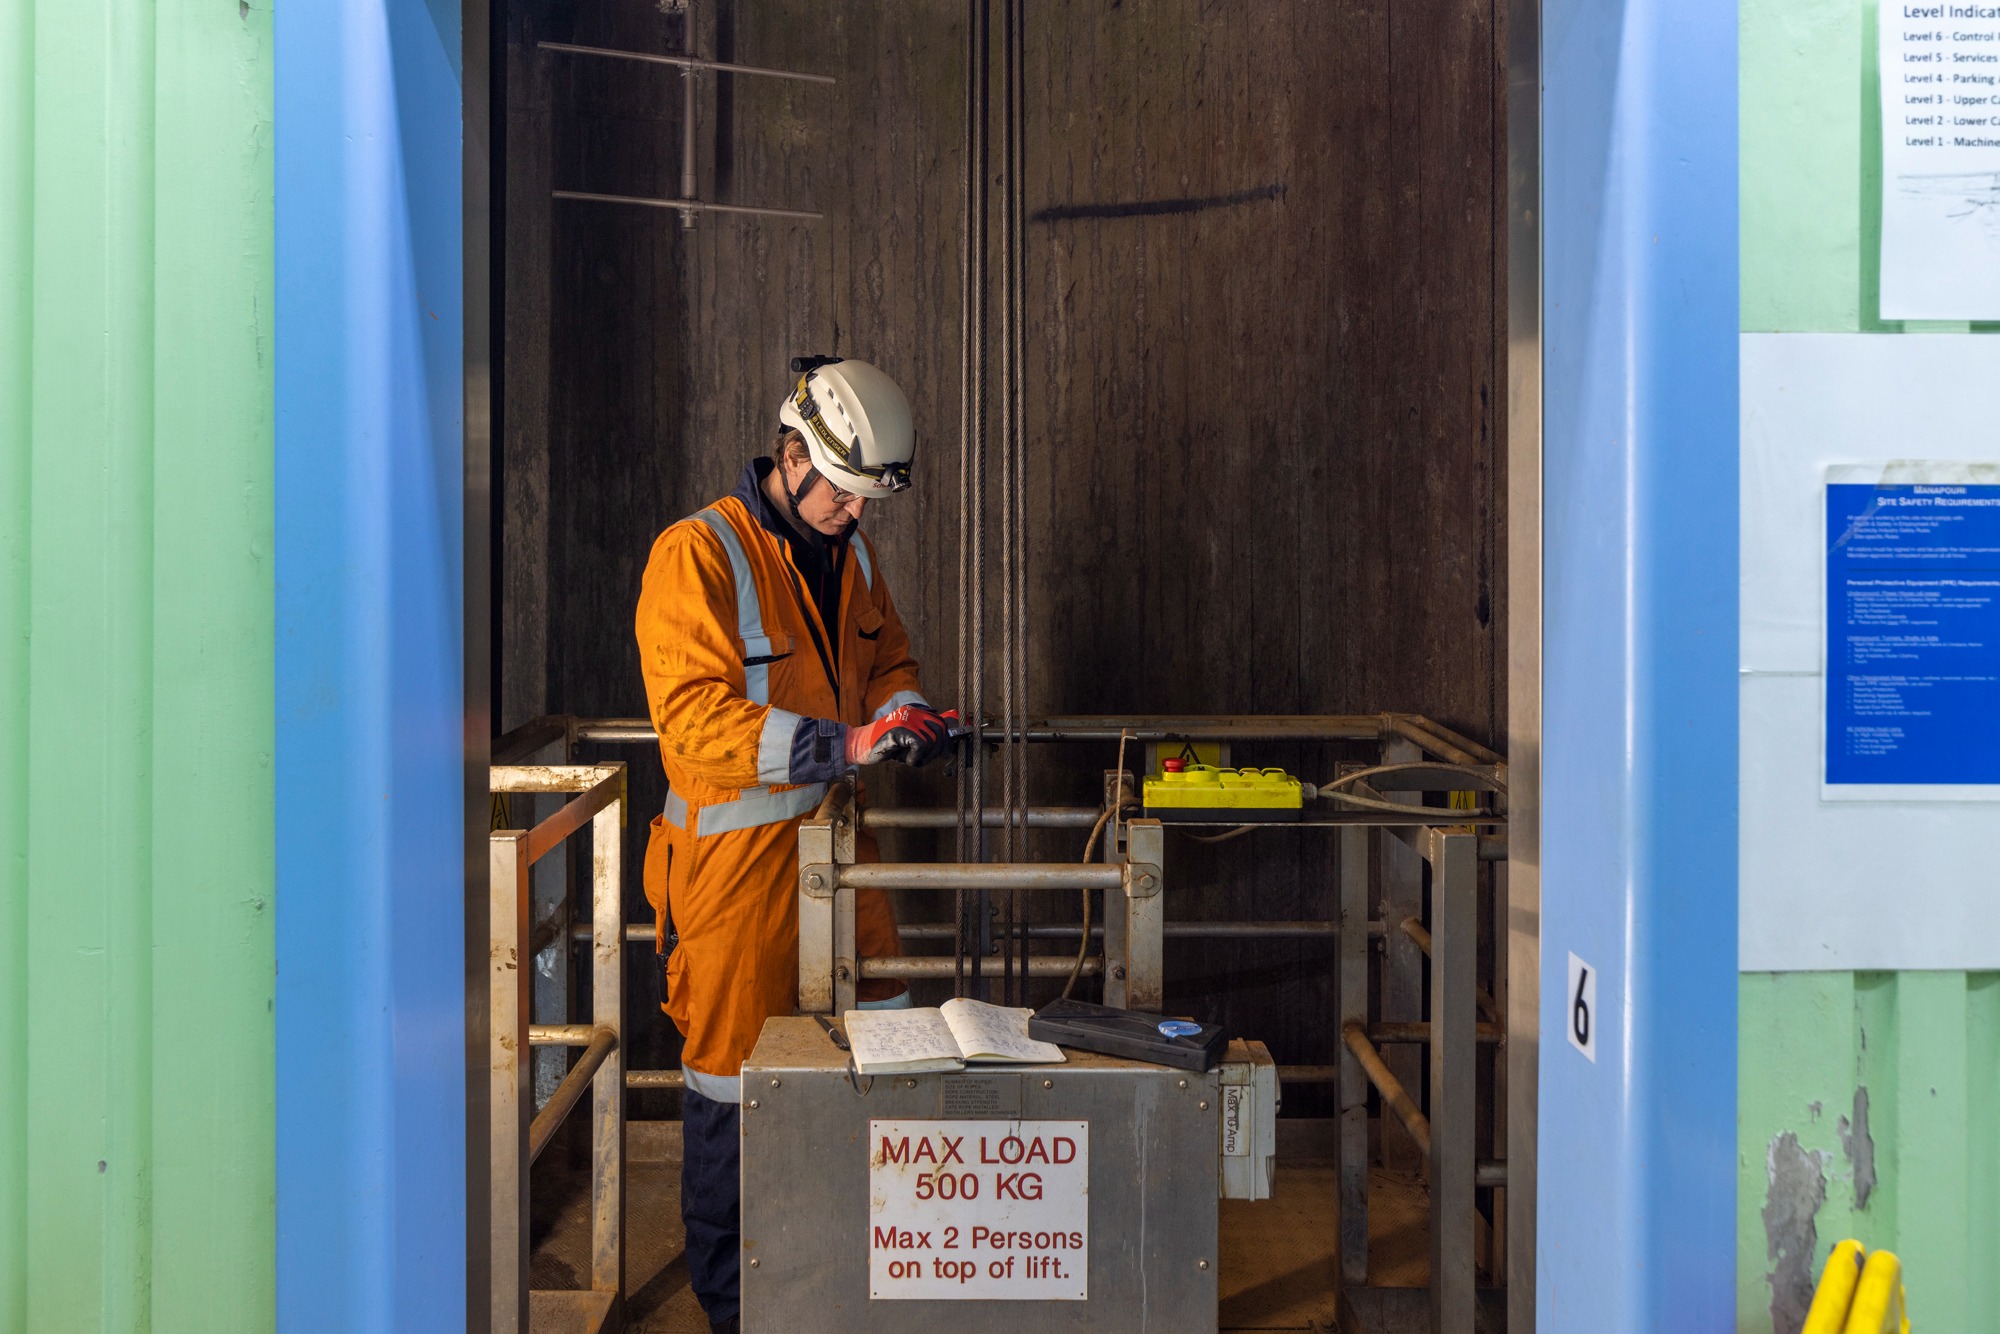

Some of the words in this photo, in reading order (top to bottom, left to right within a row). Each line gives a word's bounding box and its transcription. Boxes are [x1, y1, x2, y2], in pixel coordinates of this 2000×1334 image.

[1904, 5, 1944, 18] Level
[1904, 32, 1932, 41] Level
[1936, 32, 1942, 41] 6
[1953, 32, 1994, 41] Control
[1904, 53, 1932, 62] Level
[1936, 53, 1942, 62] 5
[1953, 53, 1998, 62] Services
[1905, 74, 1933, 83] Level
[1937, 74, 1943, 83] 4
[1953, 74, 1994, 86] Parking
[1905, 95, 1933, 104] Level
[1937, 95, 1943, 104] 3
[1954, 95, 1987, 106] Upper
[1906, 116, 1934, 125] Level
[1938, 116, 1944, 125] 2
[1954, 116, 1987, 125] Lower
[1906, 137, 1934, 146] Level
[1938, 137, 1944, 146] 1
[1877, 497, 1897, 506] SITE
[1899, 497, 1932, 506] SAFETY
[1574, 967, 1589, 1046] 6
[1228, 1089, 1237, 1112] Max
[1228, 1115, 1237, 1127] 10
[1225, 1129, 1237, 1153] Amp
[882, 1137, 964, 1164] MAX
[981, 1136, 1076, 1164] LOAD
[916, 1173, 979, 1200] 500
[996, 1173, 1043, 1200] KG
[874, 1226, 932, 1249] Max
[943, 1227, 959, 1249] 2
[972, 1226, 1083, 1249] Persons
[888, 1260, 921, 1279] on
[933, 1257, 977, 1284] top
[988, 1256, 1014, 1279] of
[1026, 1256, 1070, 1279] lift.
